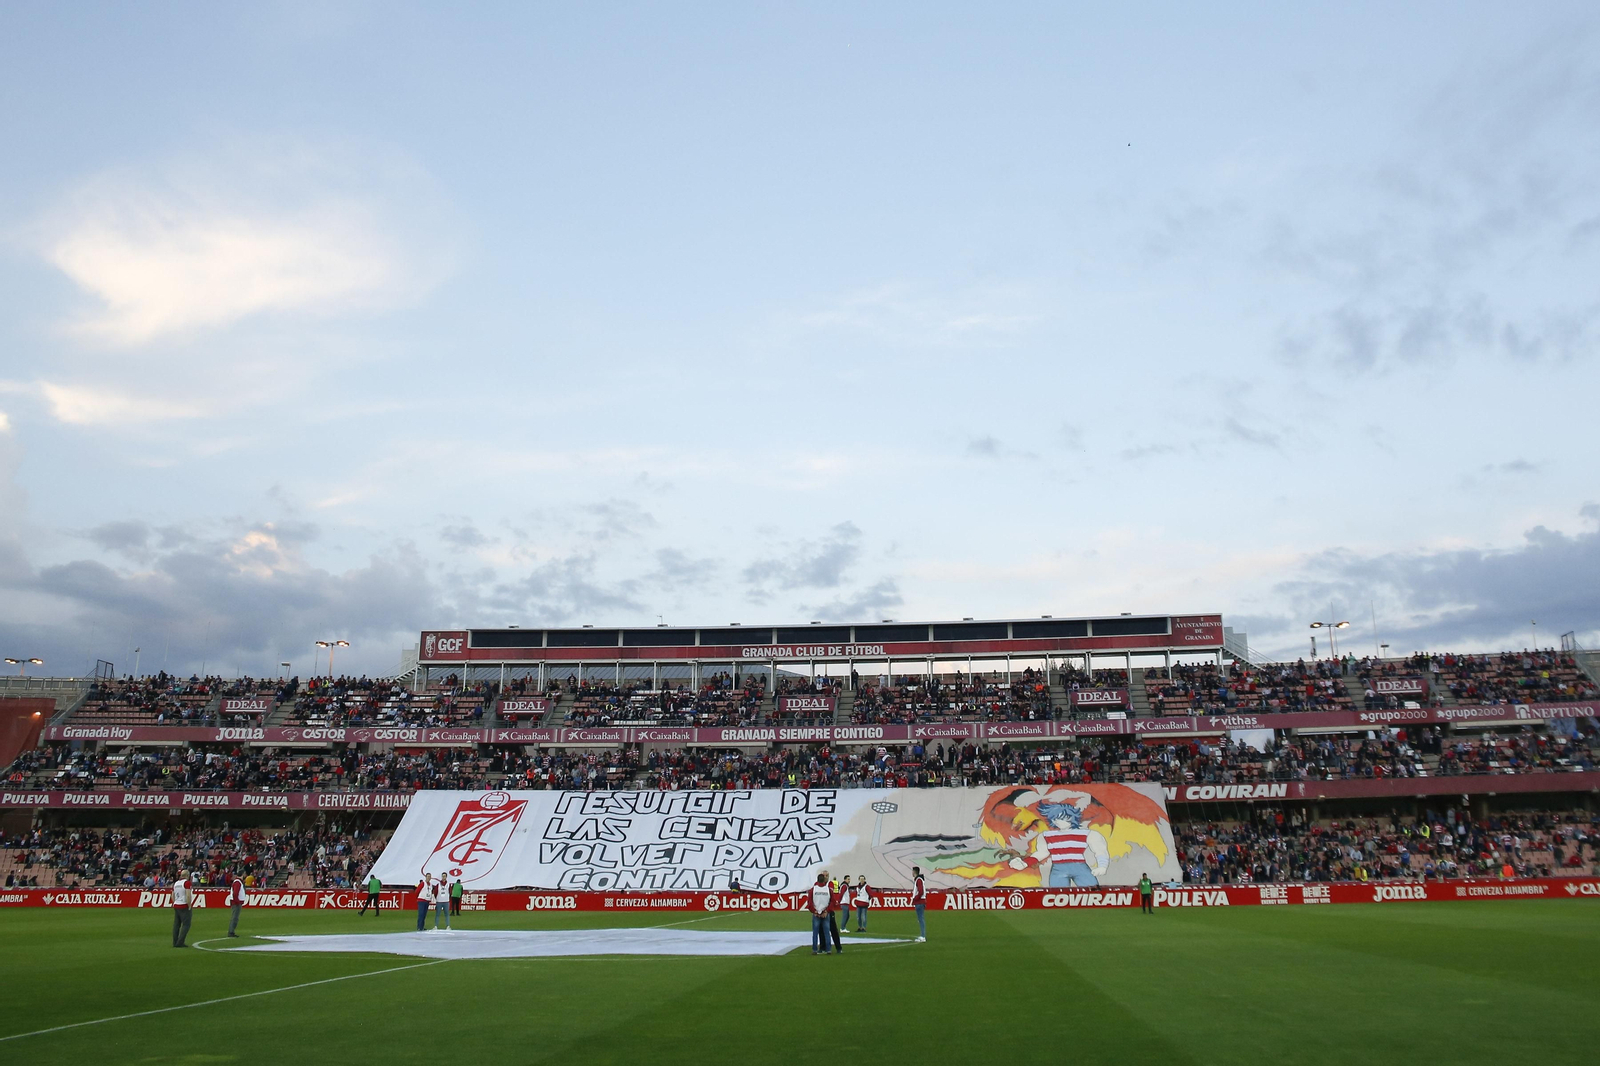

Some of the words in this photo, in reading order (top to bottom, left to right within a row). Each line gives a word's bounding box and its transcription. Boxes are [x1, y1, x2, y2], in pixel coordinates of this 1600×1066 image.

[1175, 621, 1222, 629] AYUNTAMIENTO
[437, 638, 464, 652] GCF
[742, 647, 793, 658] GRANADA
[796, 646, 825, 657] CLUB
[828, 646, 842, 656] DE
[846, 643, 887, 656] FÚTBOL
[1376, 680, 1422, 691] IDEAL
[1077, 691, 1122, 702] IDEAL
[226, 699, 267, 710] IDEAL
[503, 701, 545, 711] IDEAL
[786, 698, 829, 708] IDEAL
[1368, 709, 1428, 723] grupo2000
[1444, 706, 1505, 719] grupo2000
[1532, 706, 1595, 718] NEPTUNO
[1147, 720, 1190, 730] CaixaBank
[1221, 715, 1258, 725] vithas
[927, 727, 970, 737] CaixaBank
[1000, 725, 1042, 735] CaixaBank
[1074, 722, 1116, 732] CaixaBank
[63, 726, 109, 738] Granada
[110, 727, 132, 740] Hoy
[302, 728, 346, 739] CASTOR
[374, 729, 418, 740] CASTOR
[441, 731, 481, 741] CaixaBank
[510, 731, 550, 741] CaixaBank
[579, 731, 620, 741] CaixaBank
[649, 731, 691, 740] CaixaBank
[721, 729, 776, 740] GRANADA
[779, 728, 830, 740] SIEMPRE
[833, 727, 884, 738] CONTIGO
[1186, 783, 1288, 800] COVIRAN
[2, 793, 50, 804] PULEVA
[62, 794, 110, 805] PULEVA
[122, 794, 170, 805] PULEVA
[182, 794, 229, 806] PULEVA
[241, 794, 288, 806] PULEVA
[318, 794, 370, 807] CERVEZAS
[780, 789, 837, 815] DE
[542, 817, 633, 842] LAS
[659, 816, 834, 843] CENIZAS
[1468, 886, 1504, 896] CERVEZAS
[1504, 885, 1544, 895] ALHAMBRA
[1579, 882, 1600, 895] CA
[55, 893, 82, 904] CAJA
[83, 893, 122, 904] RURAL
[138, 891, 206, 908] PULA
[337, 894, 400, 908] Caixank
[616, 898, 648, 907] CERVEZAS
[650, 898, 687, 907] ALHAMBRA
[722, 894, 770, 911] LaLiga
[851, 897, 882, 908] CA
[883, 897, 916, 908] RUR
[943, 893, 1006, 910] Allianz
[1042, 892, 1133, 907] COVIRAN
[1153, 890, 1230, 907] PULEVA
